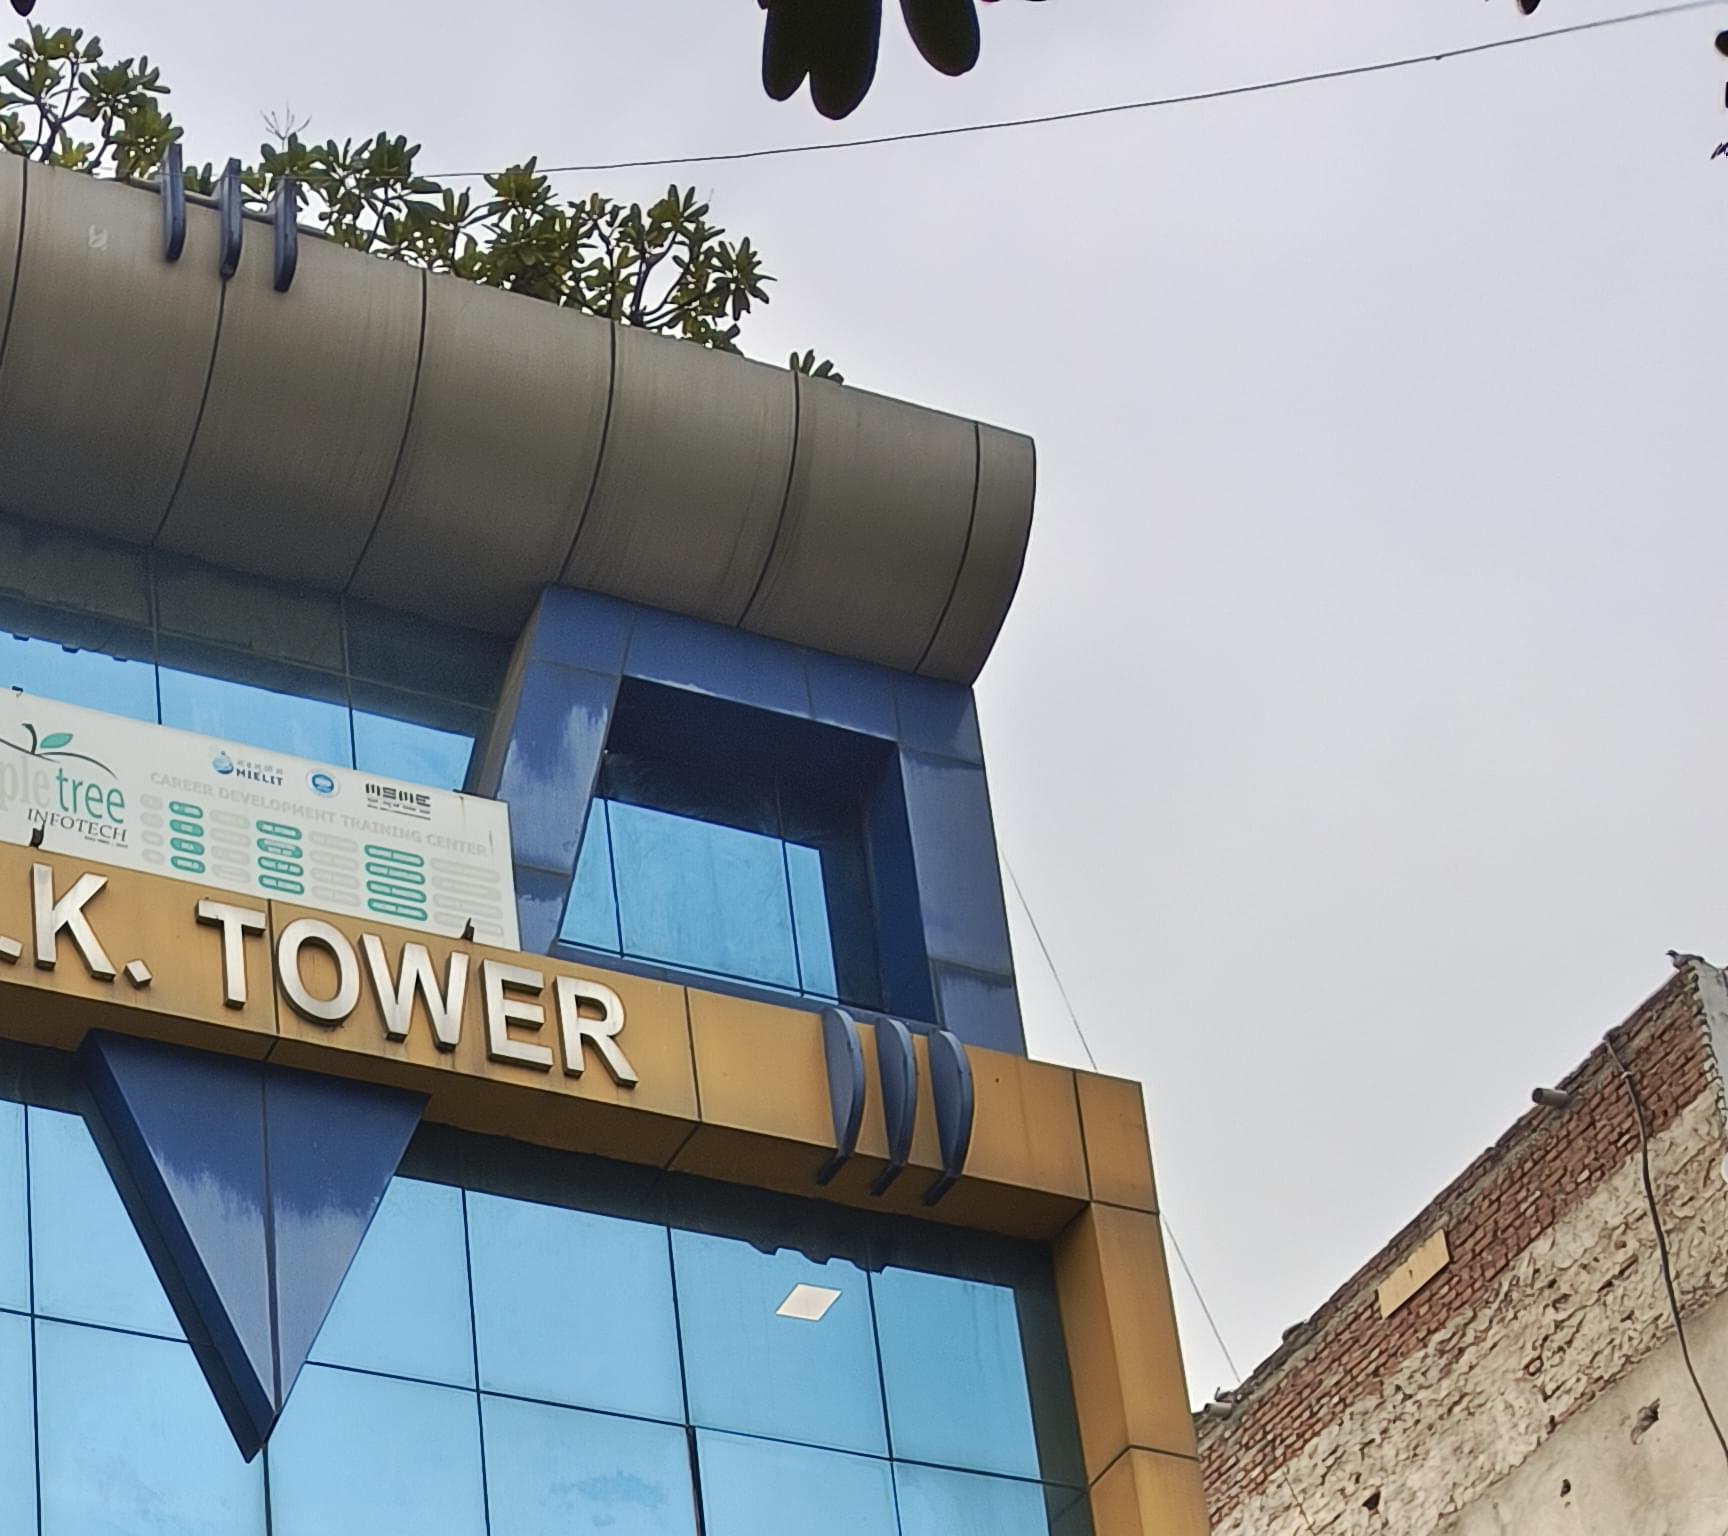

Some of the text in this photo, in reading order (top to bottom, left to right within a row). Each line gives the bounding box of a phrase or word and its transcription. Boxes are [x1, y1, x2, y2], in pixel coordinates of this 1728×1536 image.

[27, 808, 127, 842] INFOTECH
[56, 768, 125, 824] tree
[150, 771, 214, 797] CAREER
[218, 786, 336, 825] DEVELOPMENT
[339, 813, 423, 844] TRAINING
[425, 832, 489, 857] CENTER
[195, 897, 640, 1087] TOWER
